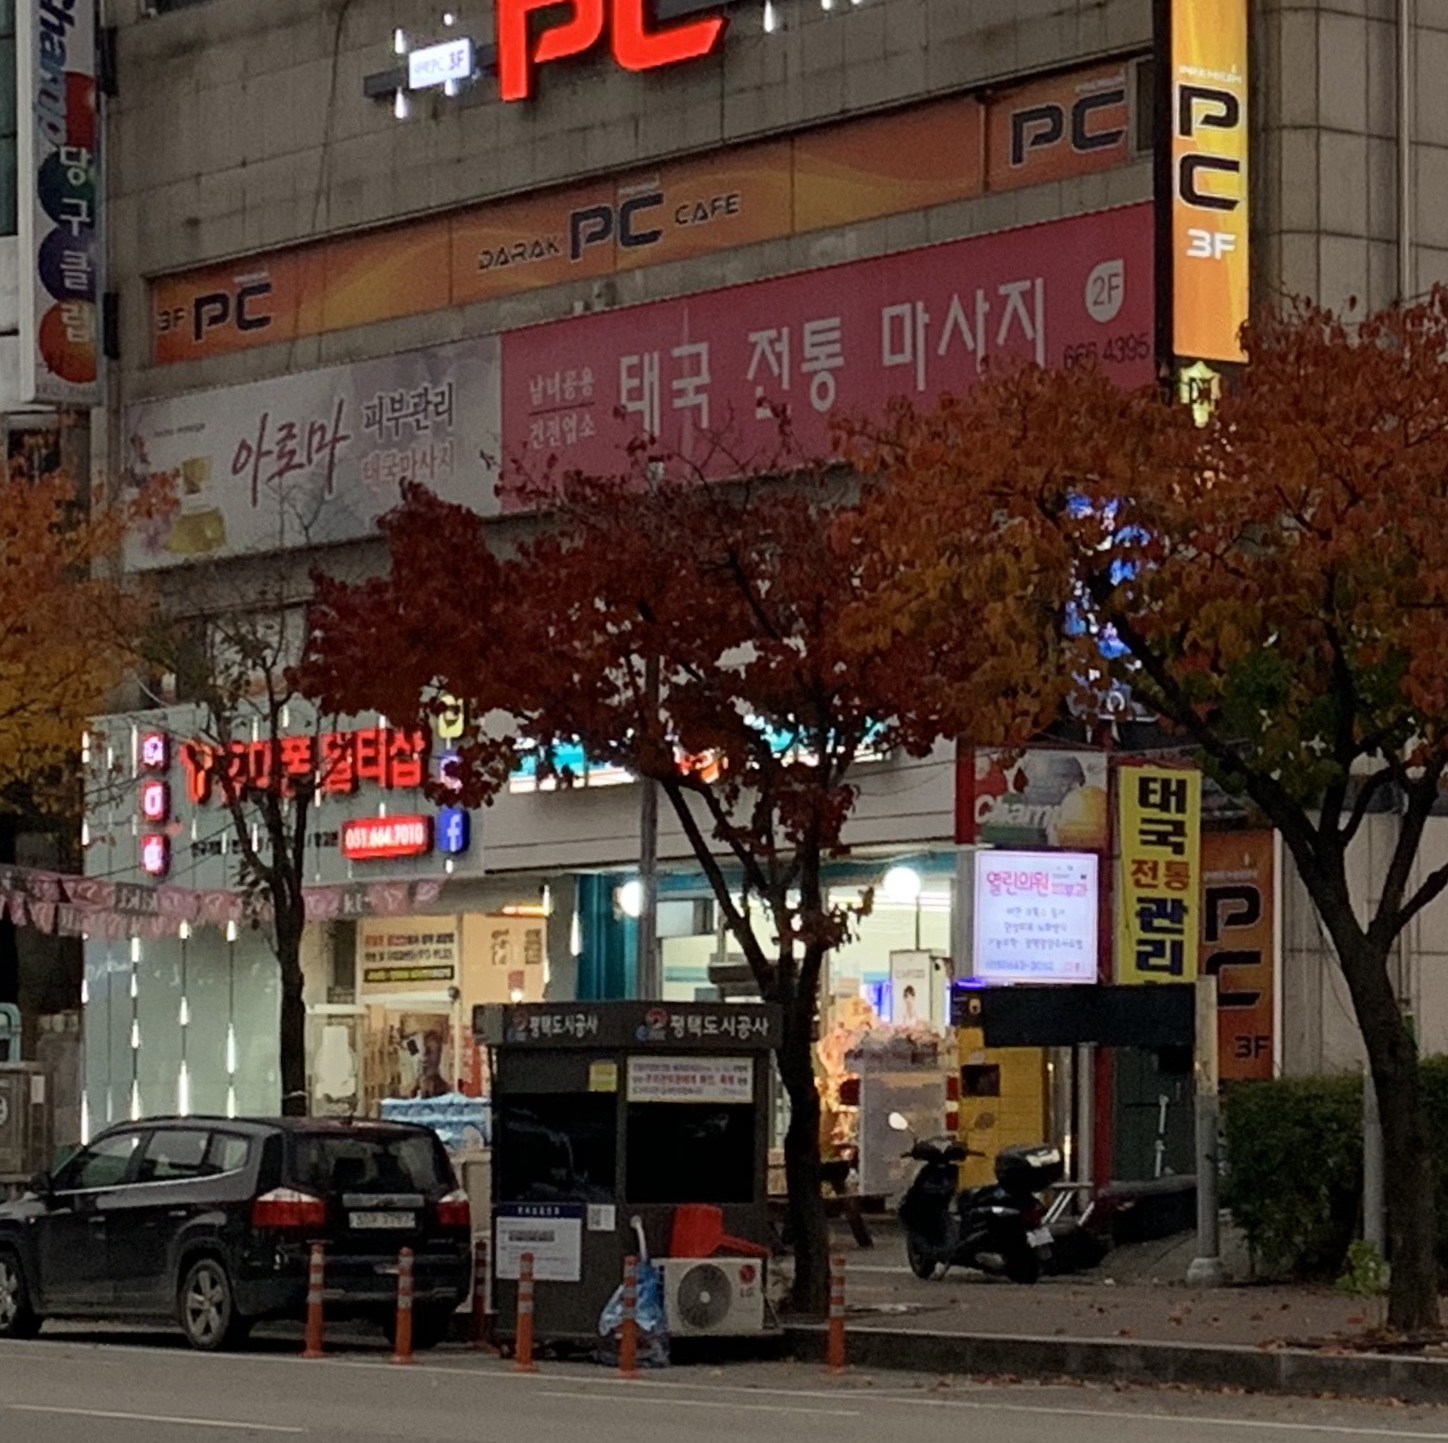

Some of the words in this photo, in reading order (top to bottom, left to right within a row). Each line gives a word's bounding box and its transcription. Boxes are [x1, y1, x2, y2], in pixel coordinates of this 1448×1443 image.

[1010, 90, 1126, 167] PC
[1178, 84, 1240, 211] PC
[477, 235, 563, 271] DARAK
[568, 192, 664, 261] PC
[674, 194, 740, 226] CAFE
[1186, 228, 1236, 260] 3F
[156, 306, 186, 333] 3F
[193, 282, 272, 342] PC
[1092, 272, 1122, 307] 2F
[619, 341, 710, 437] 태국
[747, 316, 844, 421] 전통
[883, 276, 1045, 392] 마사지
[363, 382, 454, 440] 피부관리
[231, 398, 350, 507] 아로마
[1138, 776, 1188, 857] 태국
[1131, 858, 1191, 892] 전통
[1135, 896, 1189, 977] 관리
[670, 1015, 770, 1039] 평택도시공사
[1234, 1035, 1272, 1059] 3F
